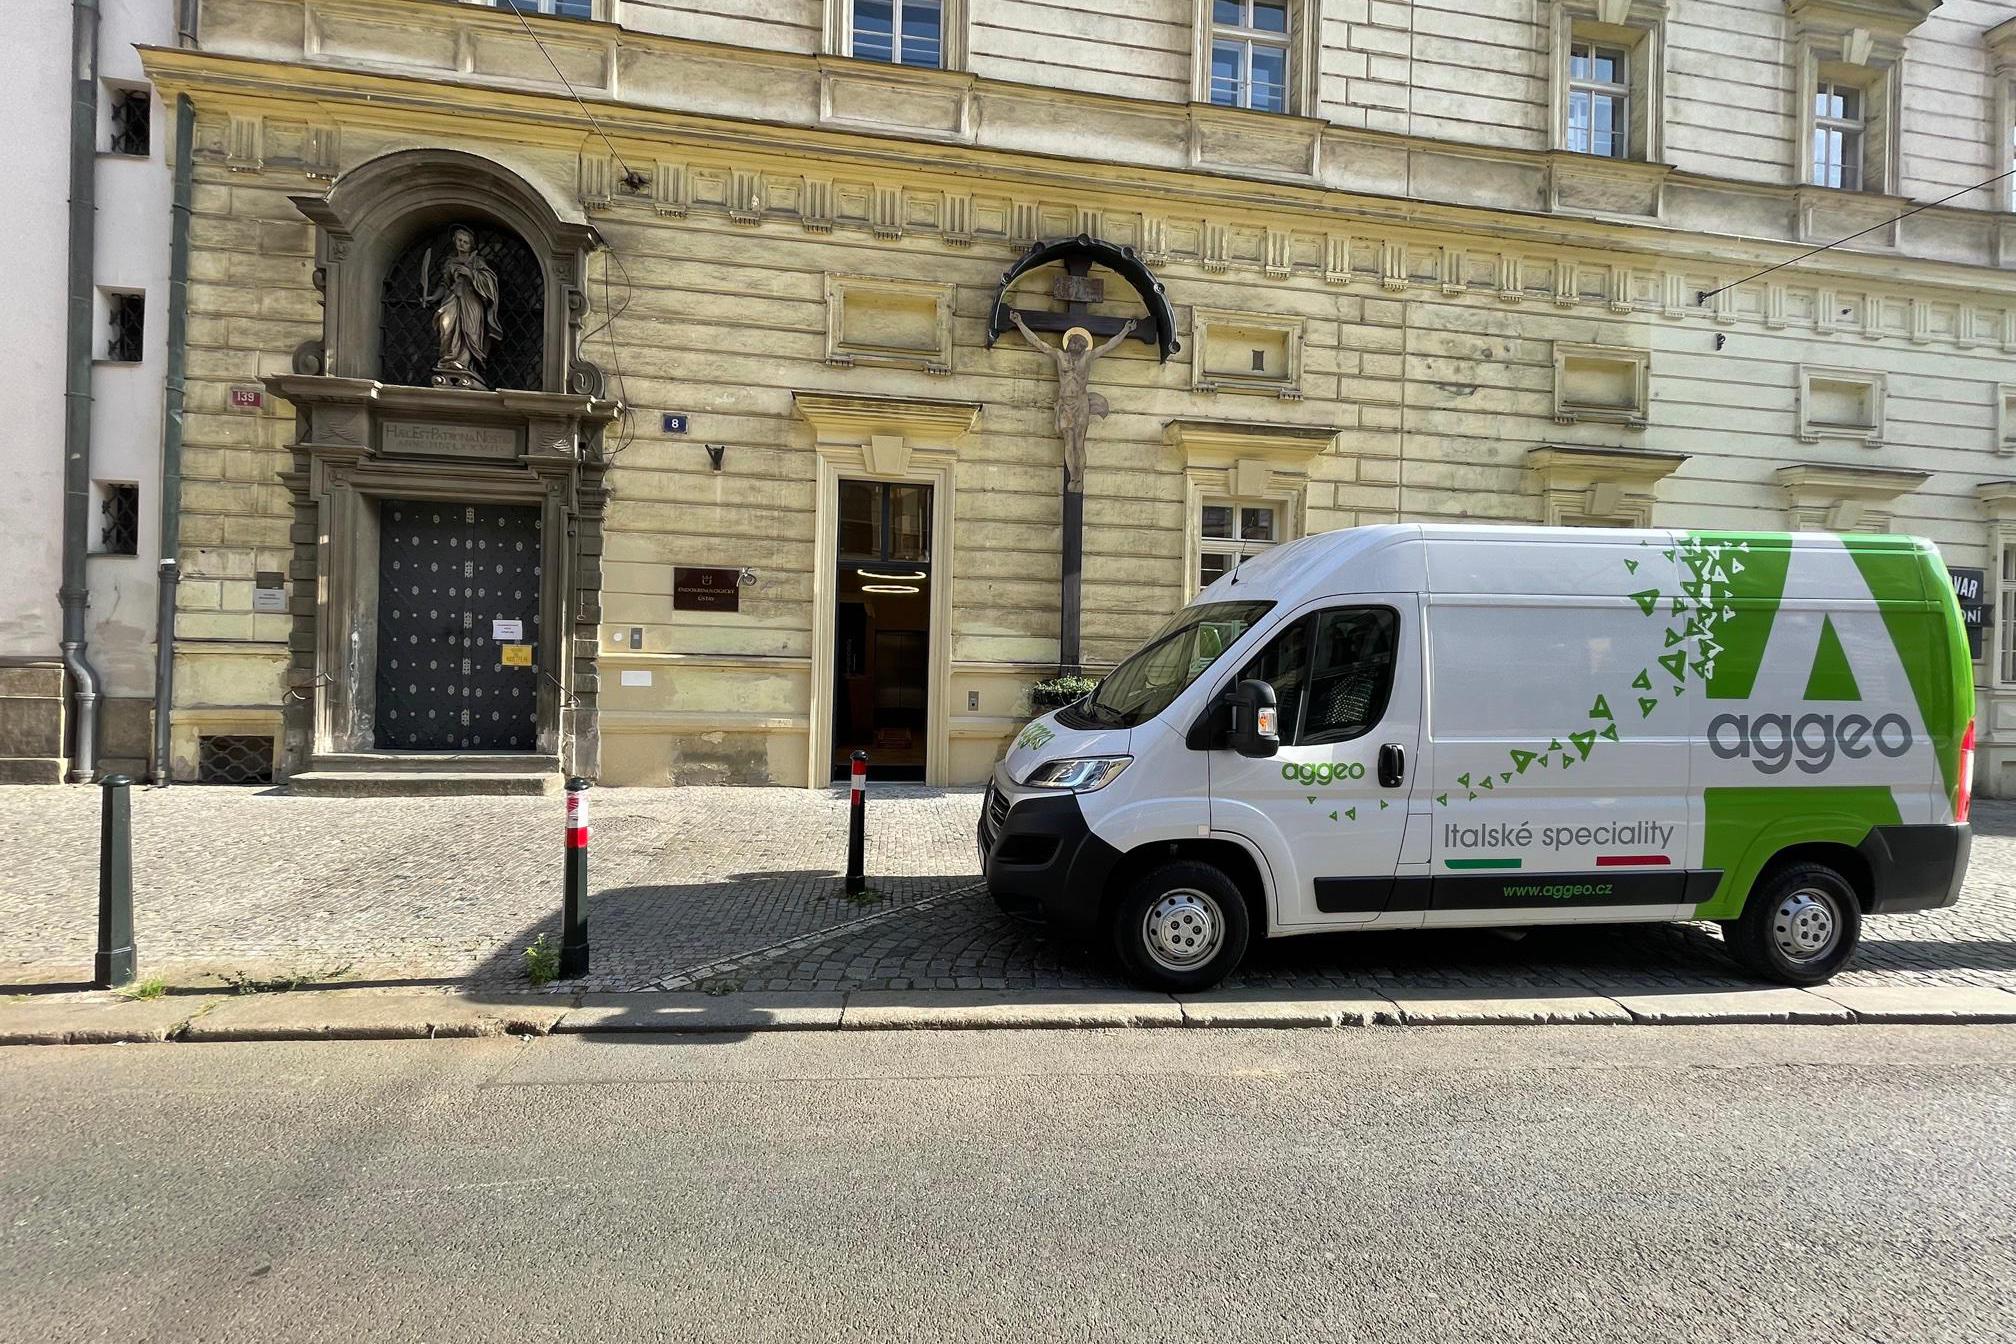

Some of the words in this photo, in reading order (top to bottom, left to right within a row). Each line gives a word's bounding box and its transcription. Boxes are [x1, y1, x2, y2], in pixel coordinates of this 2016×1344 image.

[237, 391, 255, 402] 139
[671, 418, 679, 428] 8
[1706, 713, 1913, 774] aggeo
[1282, 762, 1365, 786] aggeo
[1444, 821, 1533, 848] Italské
[1542, 820, 1674, 851] speciality
[1503, 882, 1614, 899] www.aggeo.cz
